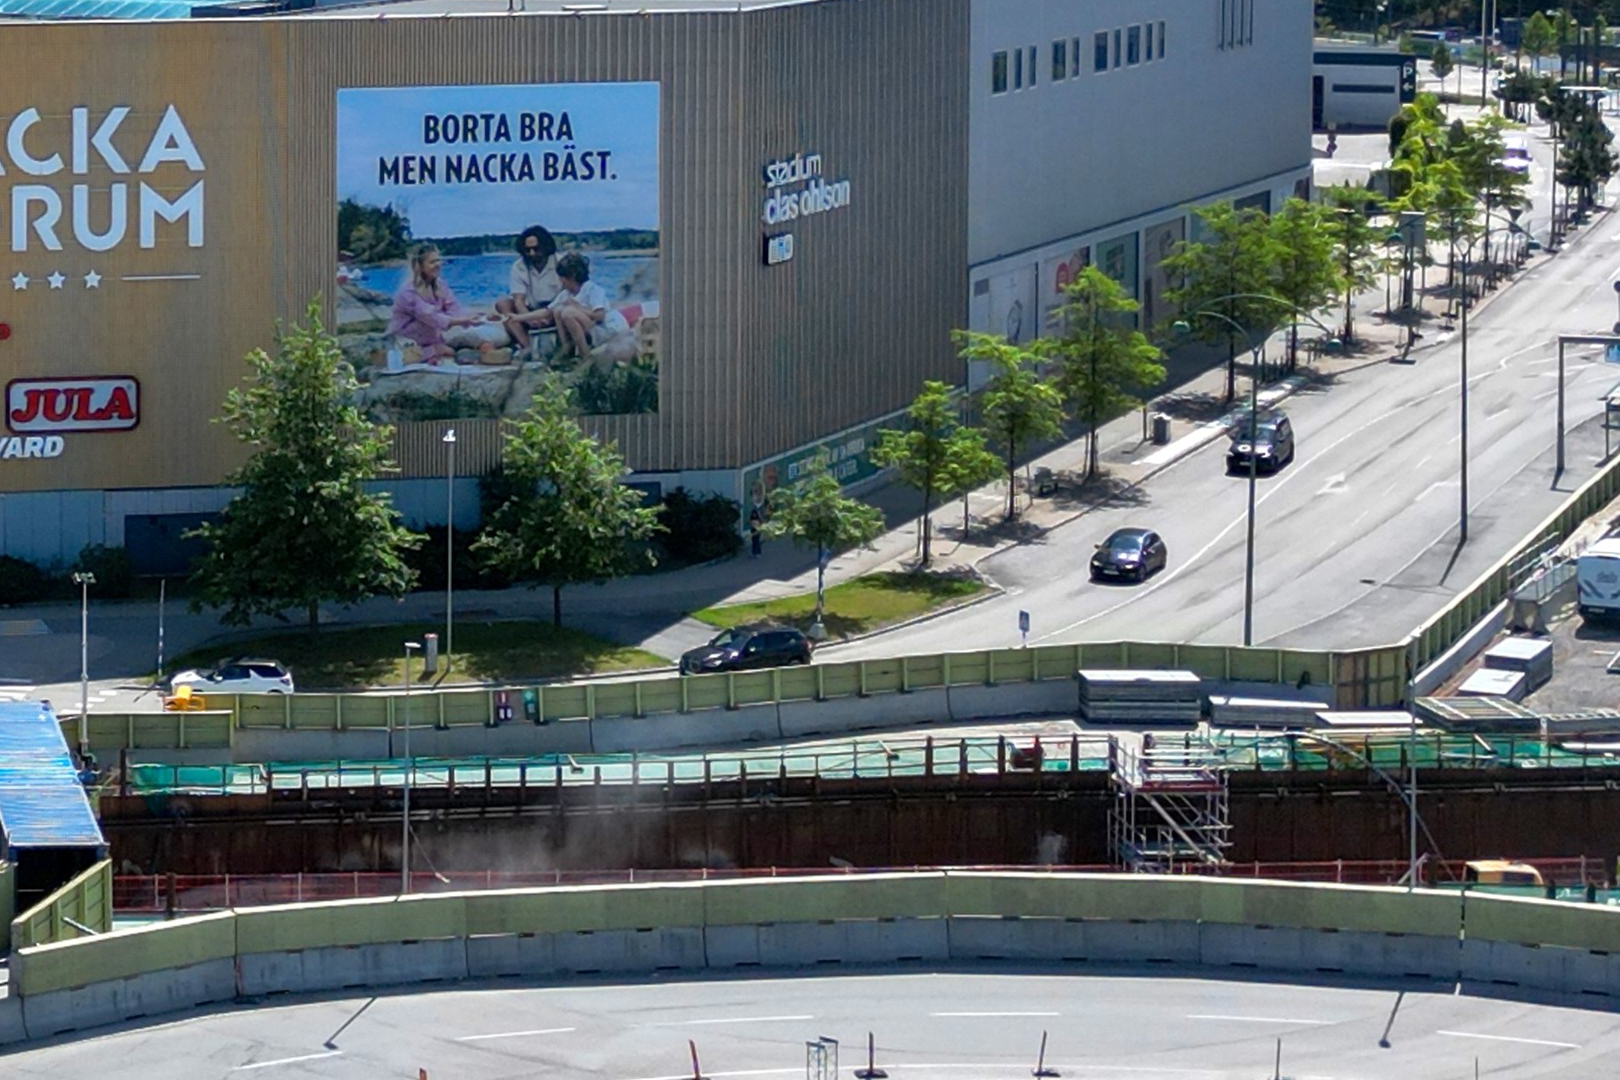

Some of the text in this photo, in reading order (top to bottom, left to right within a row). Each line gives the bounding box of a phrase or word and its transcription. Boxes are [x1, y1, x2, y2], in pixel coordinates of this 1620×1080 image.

[1403, 66, 1413, 79] P
[423, 111, 574, 144] BORTA BRA
[379, 144, 617, 185] MEN NACKA BÄST.
[766, 153, 821, 188] stadium
[11, 386, 135, 423] JULA
